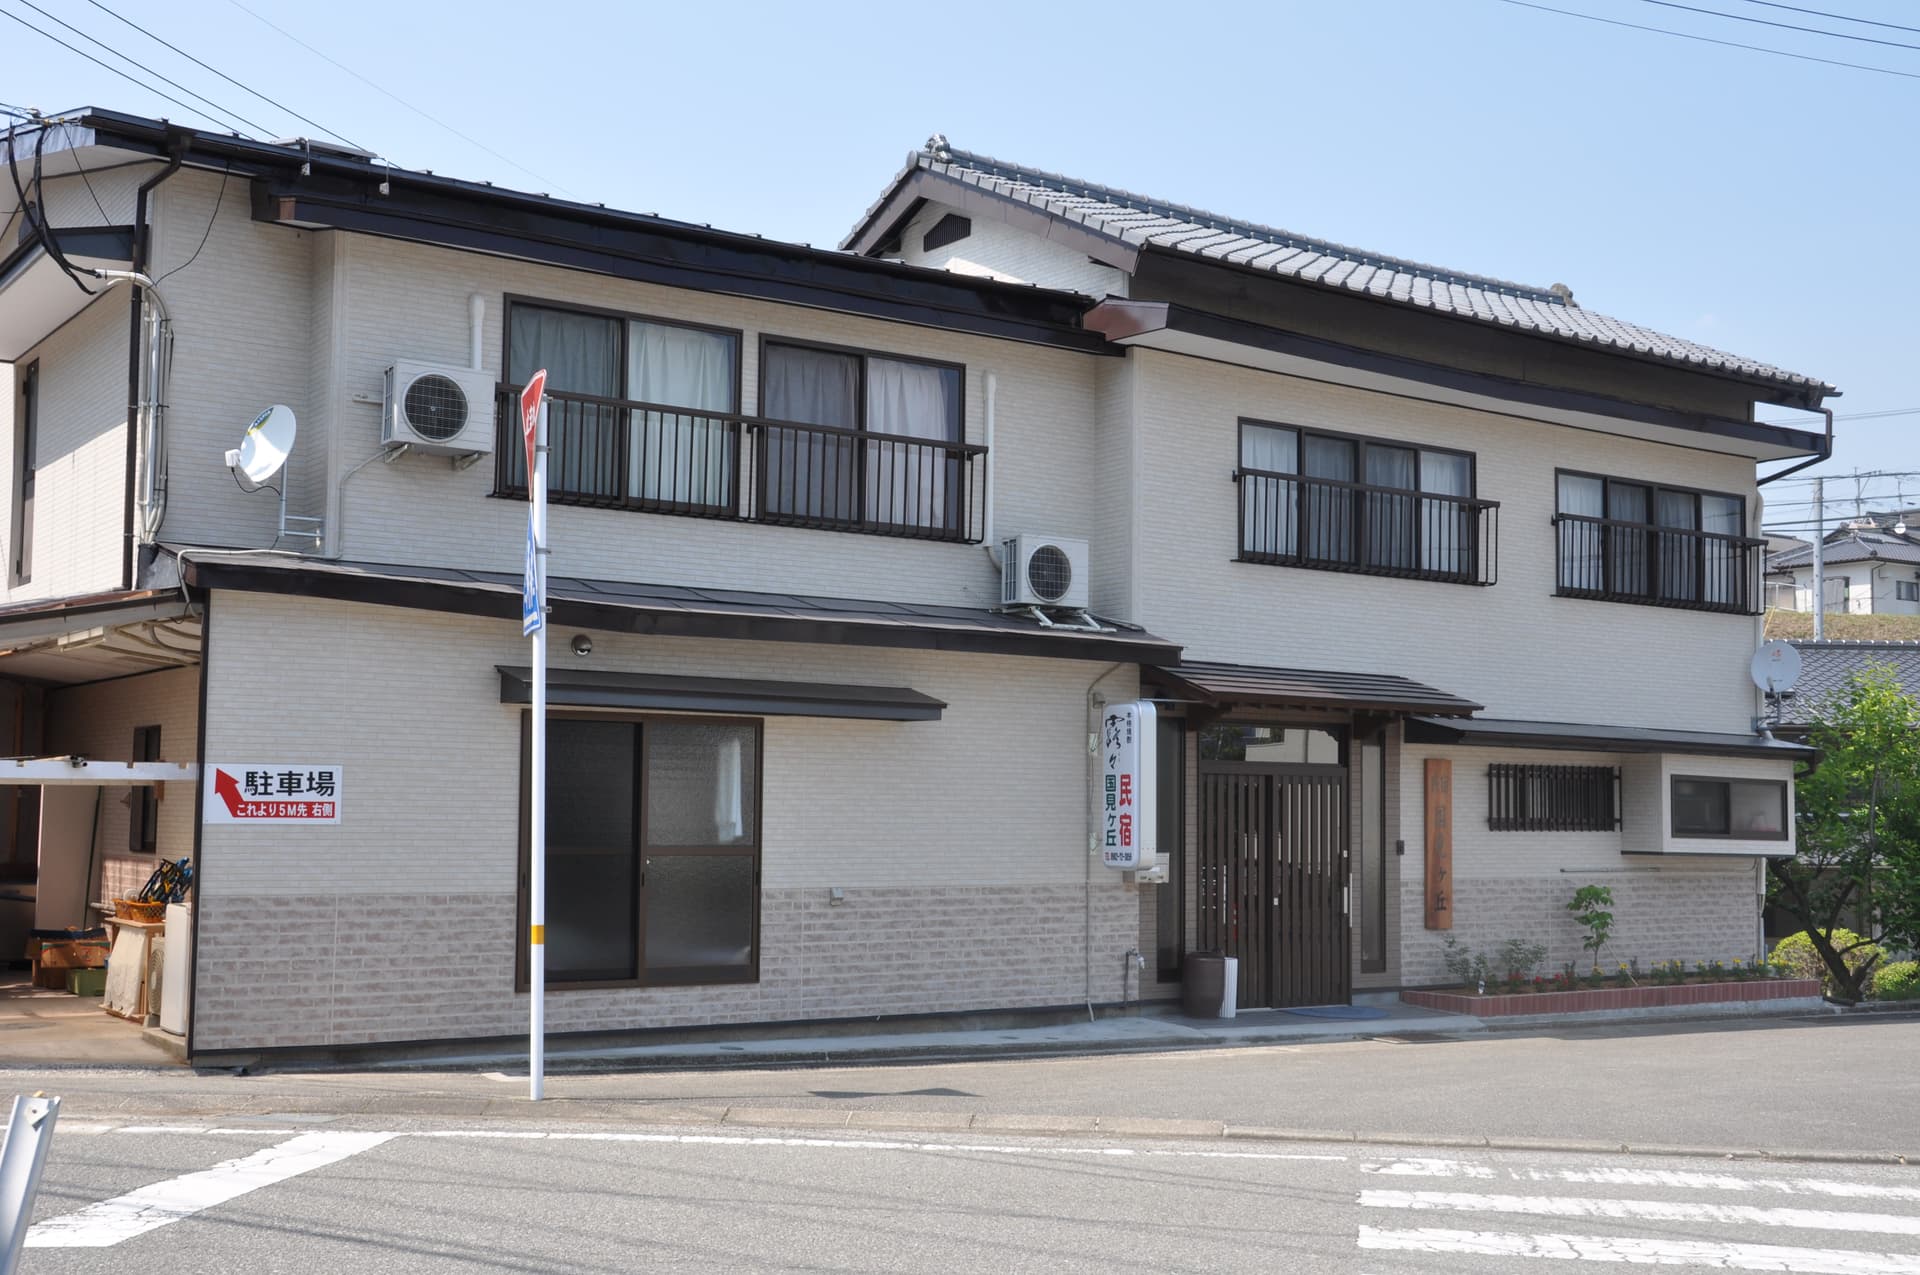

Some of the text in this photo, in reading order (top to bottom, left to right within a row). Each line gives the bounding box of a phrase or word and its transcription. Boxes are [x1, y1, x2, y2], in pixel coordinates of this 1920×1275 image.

[244, 770, 335, 797] 駐車場
[236, 803, 333, 816] これより5M先 右側
[1119, 774, 1132, 846] 民宿
